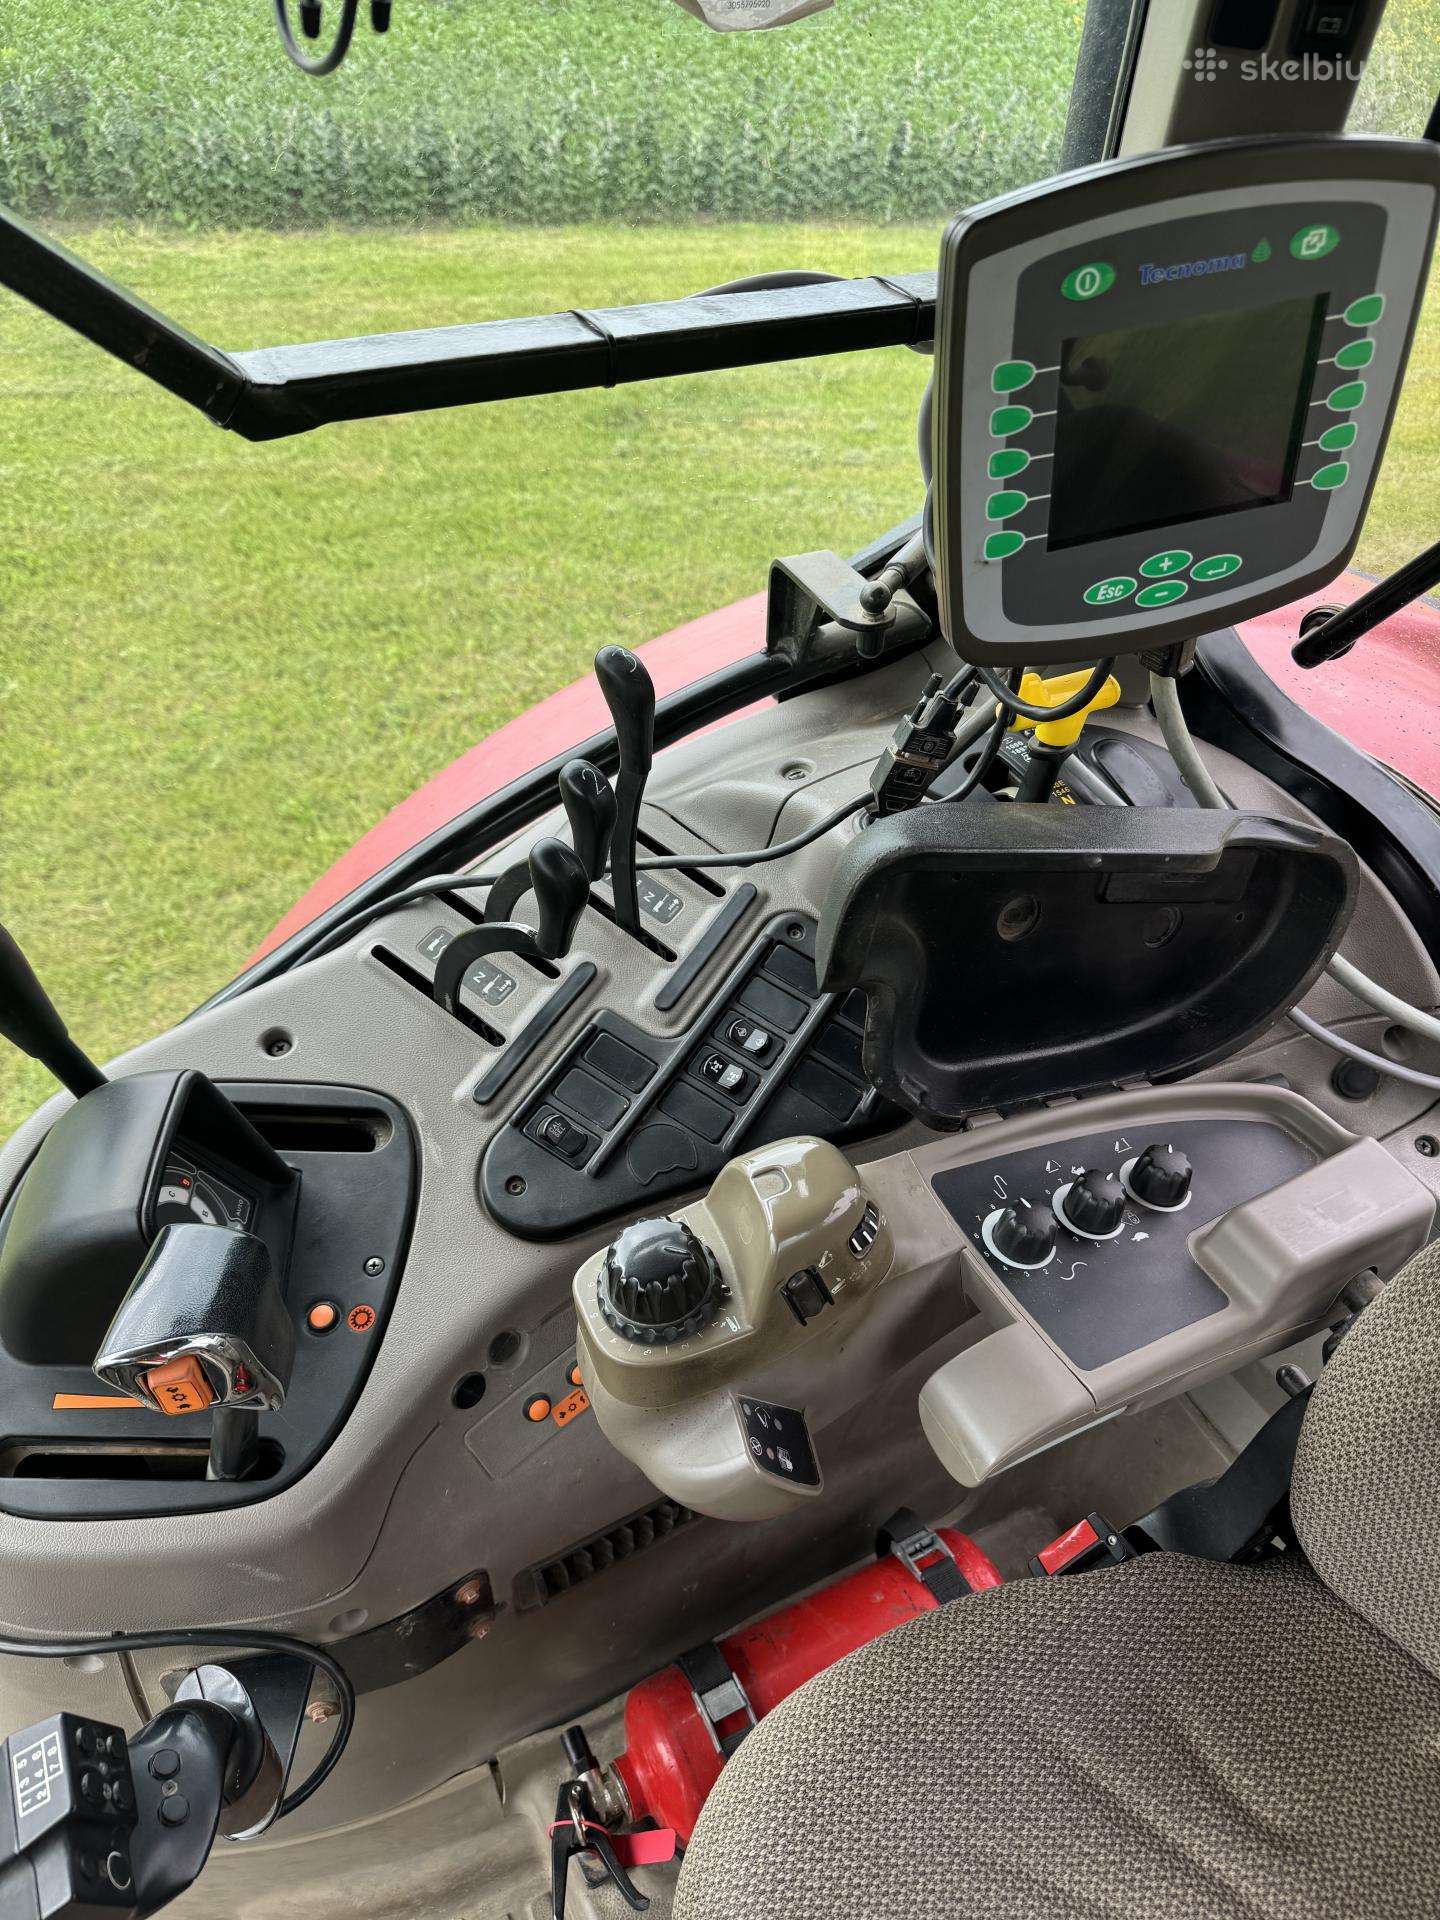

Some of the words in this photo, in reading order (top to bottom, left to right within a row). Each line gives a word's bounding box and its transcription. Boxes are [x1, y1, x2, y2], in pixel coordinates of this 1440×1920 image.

[1138, 252, 1248, 285] Tecnoma
[611, 648, 637, 673] 3
[582, 768, 607, 796] 2
[472, 971, 486, 983] N
[47, 1745, 58, 1757] 8
